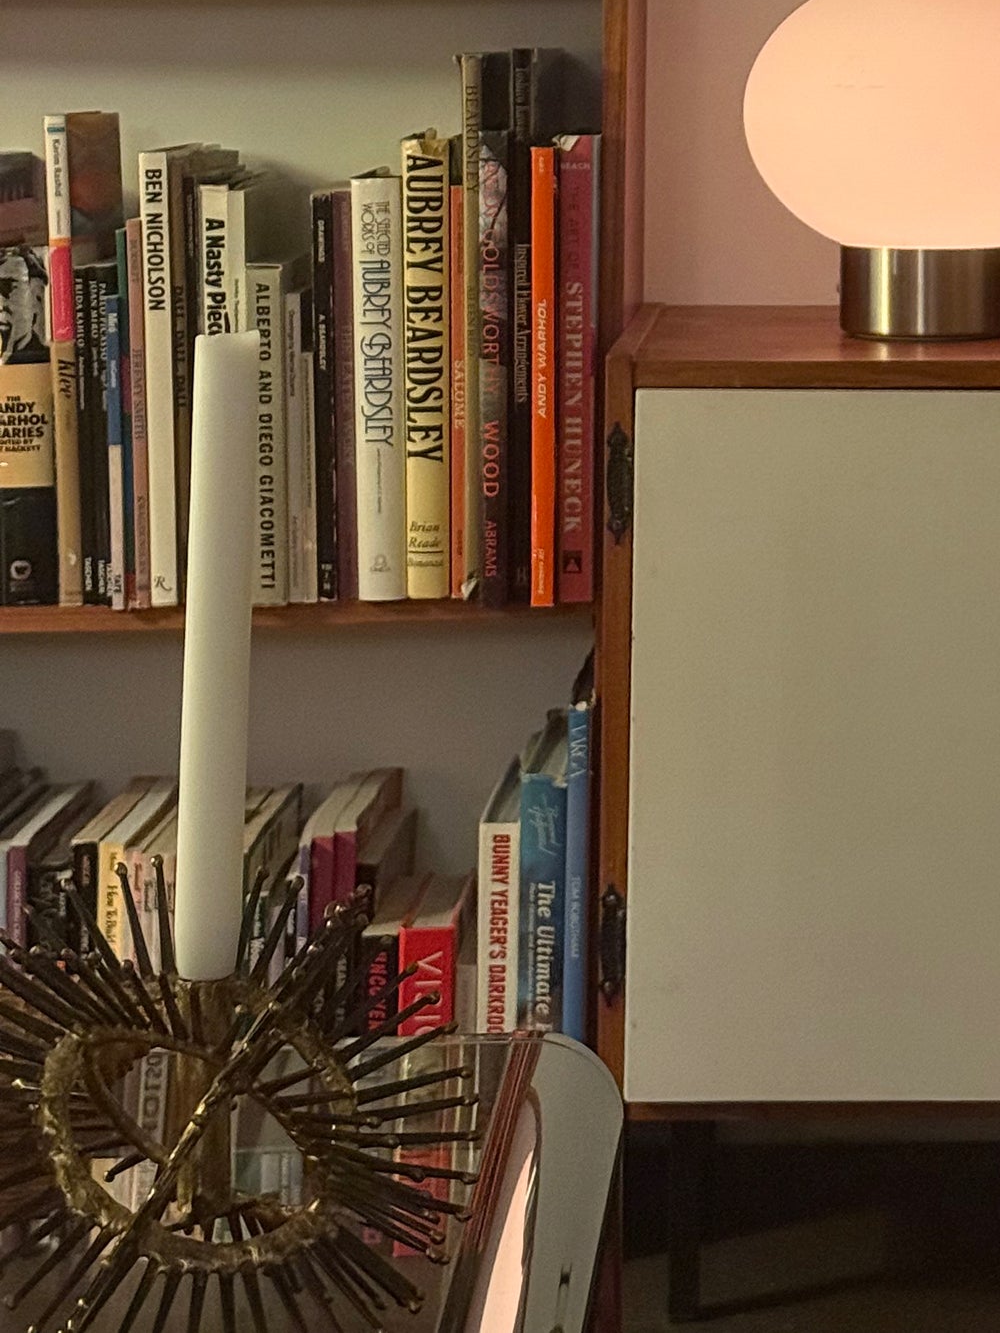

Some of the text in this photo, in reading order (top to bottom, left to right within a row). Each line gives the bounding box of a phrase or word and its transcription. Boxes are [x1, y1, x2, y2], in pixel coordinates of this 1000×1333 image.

[465, 85, 480, 195] BEARDSLEY
[144, 168, 166, 311] BEN NICHOLSON
[205, 217, 226, 232] A
[317, 219, 326, 263] DRAWINGS
[360, 202, 376, 241] WORKS
[375, 217, 391, 257] SELECTED
[204, 234, 226, 289] Nasty
[74, 277, 86, 347] FRIDA KAHLO
[405, 154, 444, 464] AUBREY BEARDSLEY
[482, 228, 501, 395] GOLDSWORTHY
[513, 243, 532, 404] Inspired Flower Arrangements
[564, 281, 585, 407] STEPHEN
[57, 359, 78, 399] Klee
[359, 259, 394, 447] AUBREY BEARDSLEY
[537, 298, 548, 419] ANDY WARHOL
[0, 426, 45, 438] ARIES
[256, 282, 276, 589] ALBERTO AND DIEGO GIACOMETTI
[483, 419, 500, 498] WOOD
[563, 416, 584, 533] HUNECK
[485, 520, 498, 578] ABRAMS
[490, 833, 511, 885] BUNNY
[488, 889, 510, 960] YEAGER'S
[536, 880, 557, 919] The
[534, 925, 556, 1017] Ultimate
